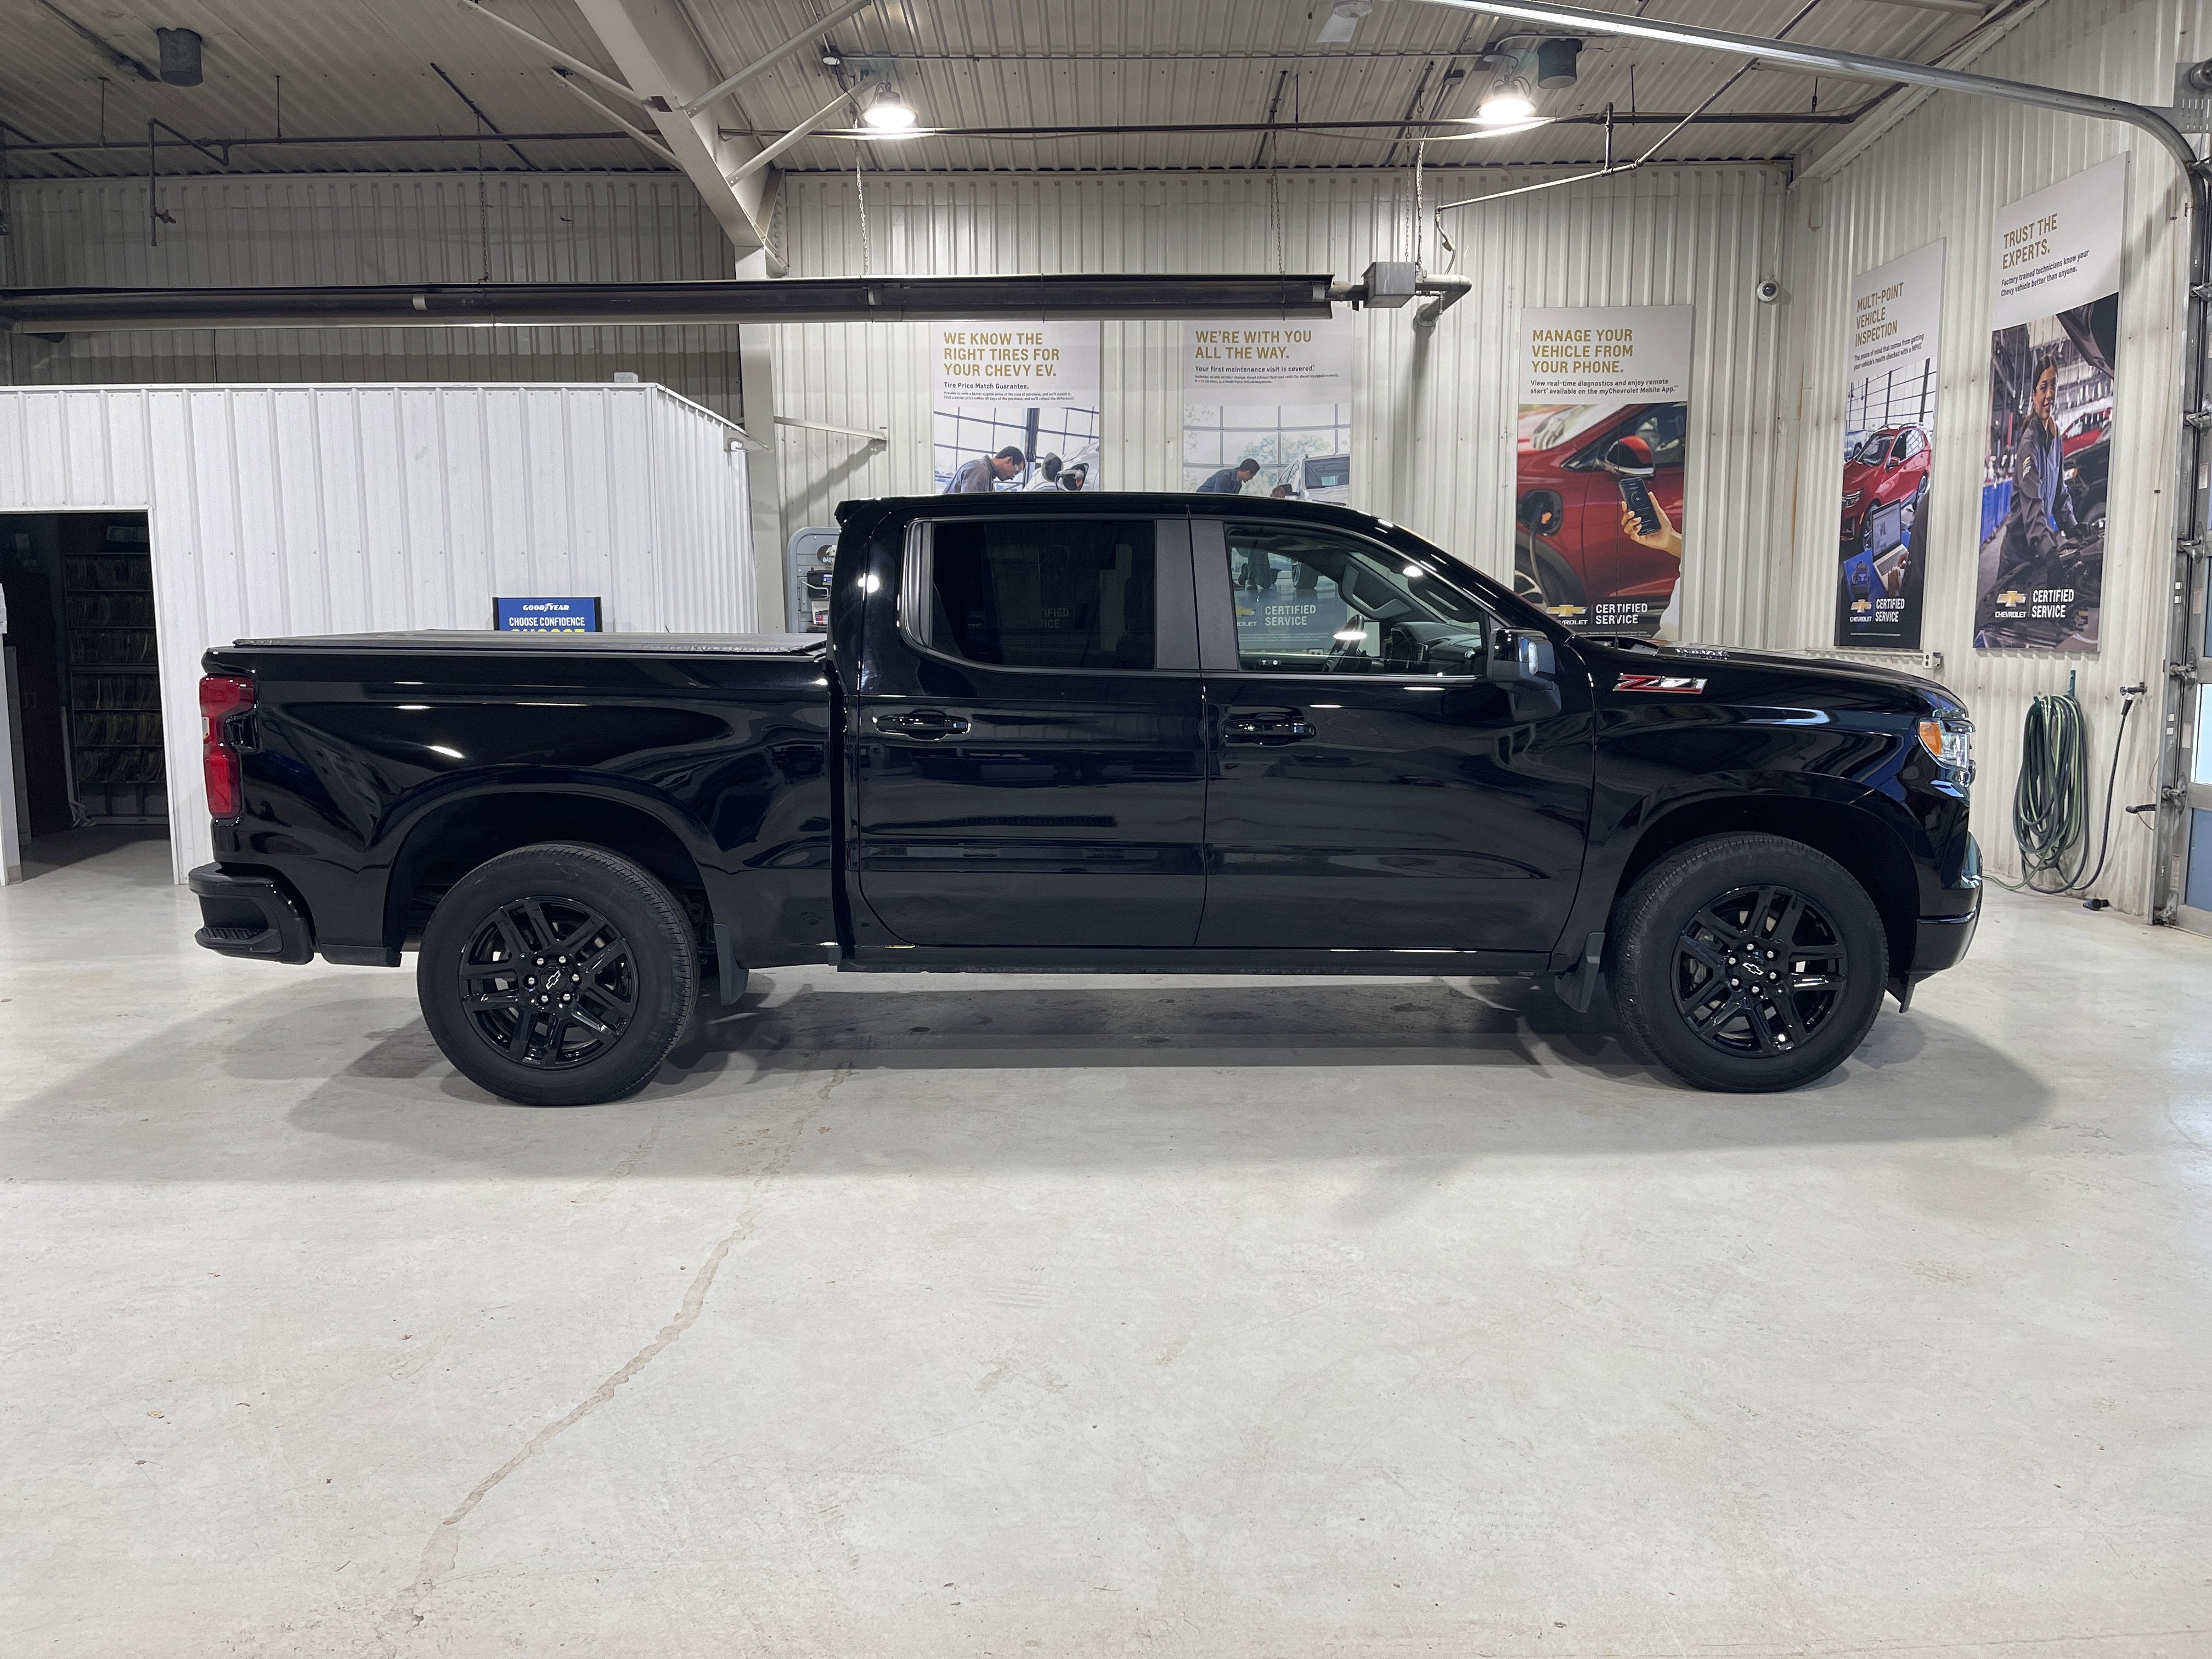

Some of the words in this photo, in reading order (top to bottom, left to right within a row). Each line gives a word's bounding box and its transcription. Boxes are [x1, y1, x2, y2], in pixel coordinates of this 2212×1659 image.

[2004, 222, 2035, 249] TRUST
[2038, 213, 2057, 235] THE
[2003, 239, 2050, 269] EXPERTS.
[2001, 276, 2018, 286] Factory
[2019, 268, 2035, 280] trained
[2036, 259, 2062, 275] technicians
[2063, 254, 2076, 264] know
[2077, 250, 2089, 262] your
[2001, 287, 2014, 296] Chevy
[2015, 281, 2030, 292] vehicle
[2032, 276, 2046, 287] better
[2047, 273, 2057, 281] than
[2058, 266, 2077, 278] anyone.
[1857, 282, 1904, 312] MULTI-POINT
[1857, 307, 1886, 329] VEHICLE
[944, 332, 965, 345] WE
[970, 333, 1012, 345] KNOW
[1017, 333, 1043, 345] THE
[1195, 330, 1239, 343] WE'RE
[1244, 331, 1279, 343] WITH
[1284, 330, 1311, 342] YOU
[1532, 330, 1592, 342] MANAGE
[1596, 329, 1633, 341] YOUR
[1855, 320, 1898, 347] INSPECTION
[944, 348, 985, 360] RIGHT
[990, 348, 1029, 360] TIRES
[1034, 349, 1059, 361] FOR
[1195, 347, 1221, 358] ALL
[1226, 347, 1252, 359] THE
[1256, 347, 1289, 359] WAY.
[1532, 345, 1590, 357] VEHICLE
[1595, 345, 1633, 357] FROM
[944, 363, 980, 376] YOUR
[985, 364, 1031, 377] CHEVY
[1036, 364, 1057, 376] EV.
[1532, 360, 1568, 373] YOUR
[1573, 360, 1623, 373] PHONE.
[2033, 589, 2074, 602] CERTIFIED
[522, 602, 570, 612] GOODYEAR
[1265, 605, 1316, 615] CERTIFIED
[1595, 603, 1648, 613] CERTIFIED
[1876, 599, 1905, 609] CERTIFIED
[1041, 608, 1069, 617] IFIED
[1875, 611, 1899, 622] SERVICE
[2032, 605, 2066, 618] SERVICE
[509, 617, 538, 626] CHOOSE
[539, 617, 585, 626] CONFIDENCE
[1265, 616, 1307, 626] SERVICE
[1595, 614, 1639, 624] SERVICE
[1612, 673, 1708, 694] Z71
